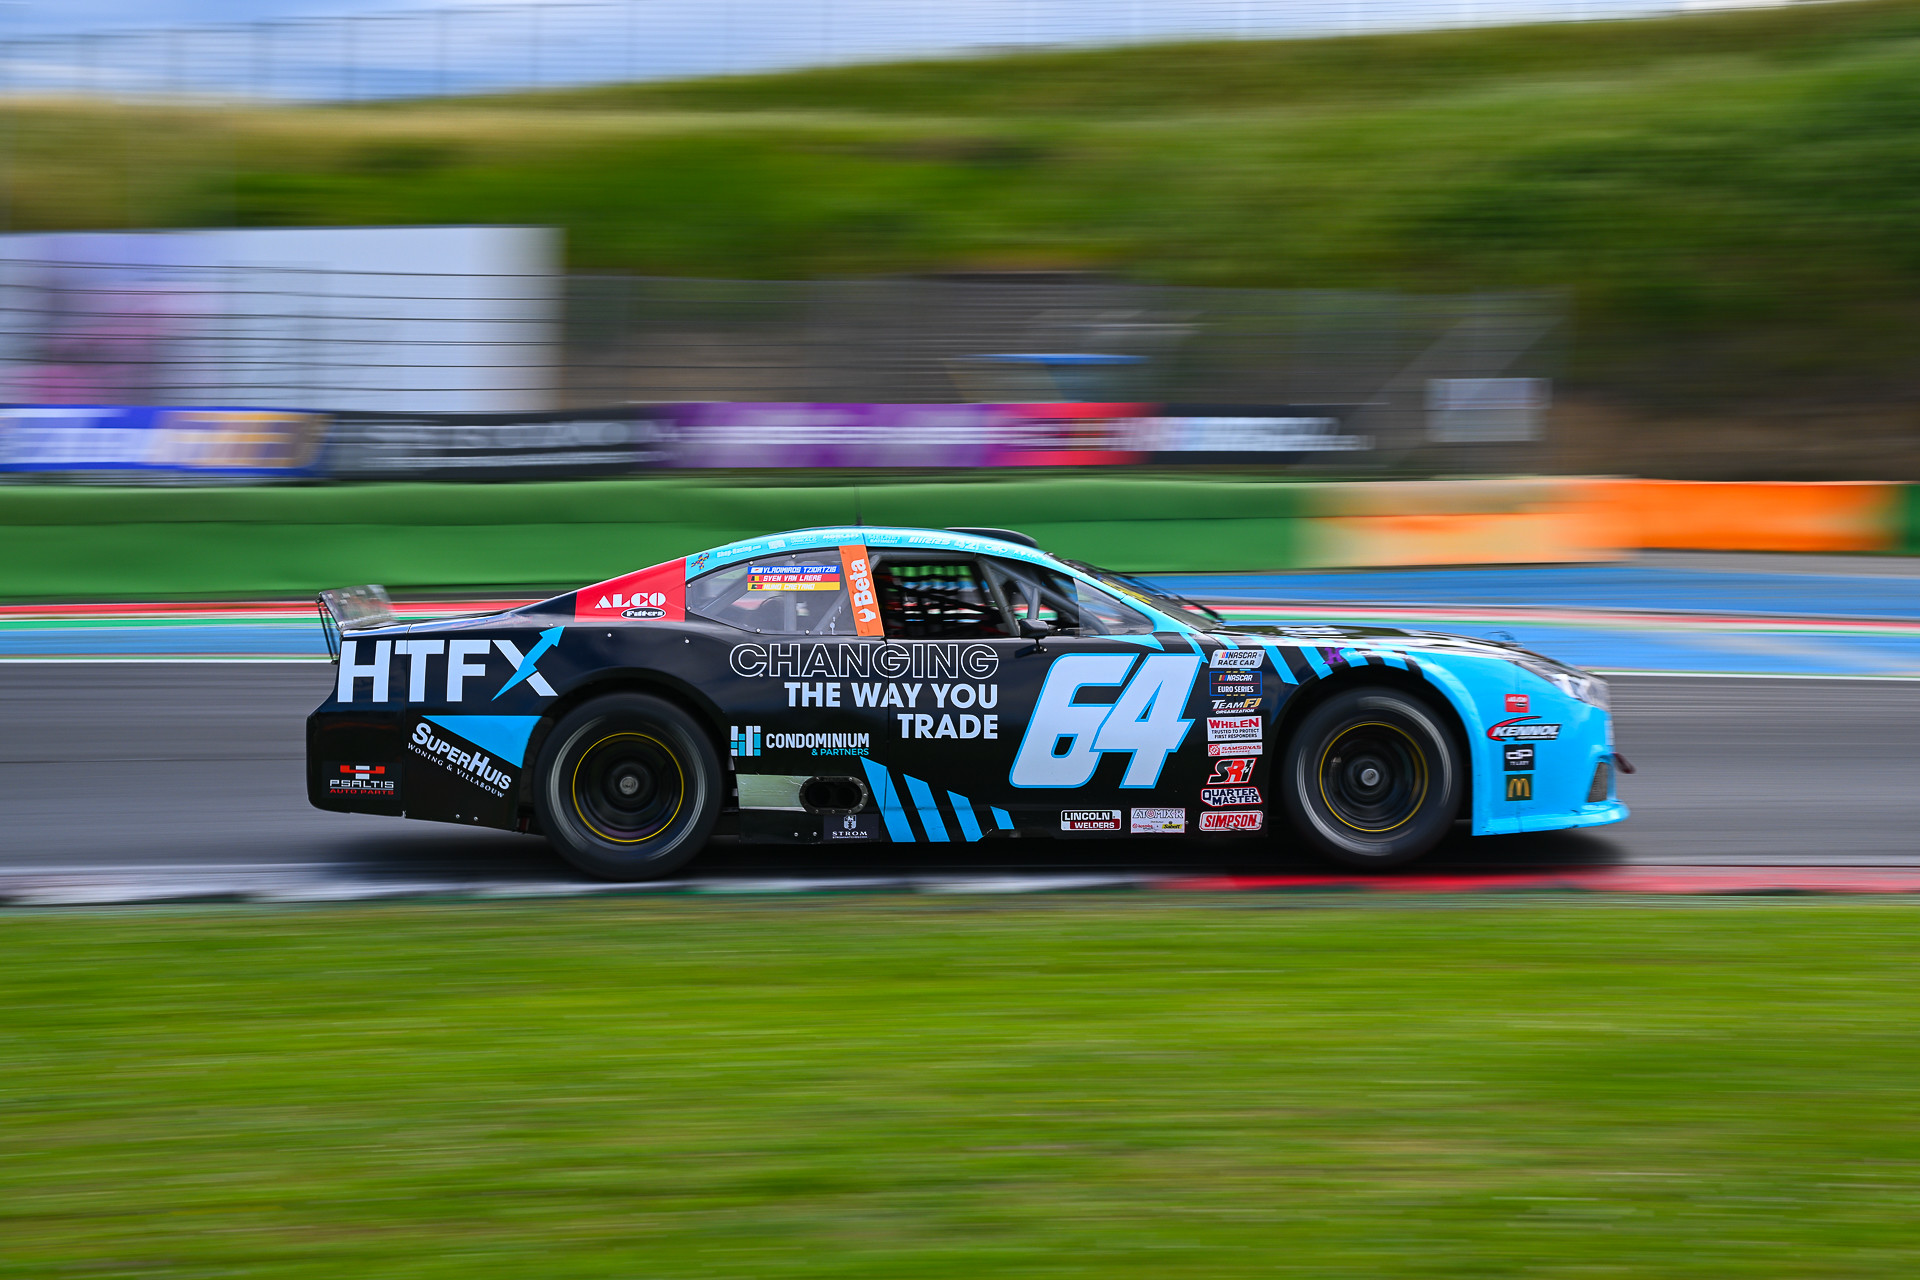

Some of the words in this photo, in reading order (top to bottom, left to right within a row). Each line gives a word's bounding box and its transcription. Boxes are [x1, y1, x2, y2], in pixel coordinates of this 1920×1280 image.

[849, 559, 874, 607] Beta
[594, 592, 666, 608] ALCO
[337, 630, 562, 702] HTFX
[729, 643, 999, 680] CHANGING
[784, 682, 841, 708] THE
[851, 682, 922, 708] WAY
[931, 683, 998, 709] YOU
[897, 714, 999, 739] TRADE
[1009, 653, 1202, 788] 64
[1208, 718, 1260, 728] WHELEN
[1492, 725, 1560, 737] KENNOL
[766, 733, 869, 748] CONDOMINIUM
[811, 748, 818, 756] &
[820, 748, 869, 756] PARTNERS
[408, 742, 444, 766] WONING
[446, 763, 453, 772] &
[457, 769, 505, 798] VILLABOUW
[330, 780, 394, 788] PSALTIS
[1203, 788, 1257, 801] QUARTER
[1212, 796, 1260, 805] MASTER
[1064, 812, 1110, 820] LINCOLN
[1204, 814, 1257, 828] SIMPSON
[1074, 821, 1115, 829] WELDERS
